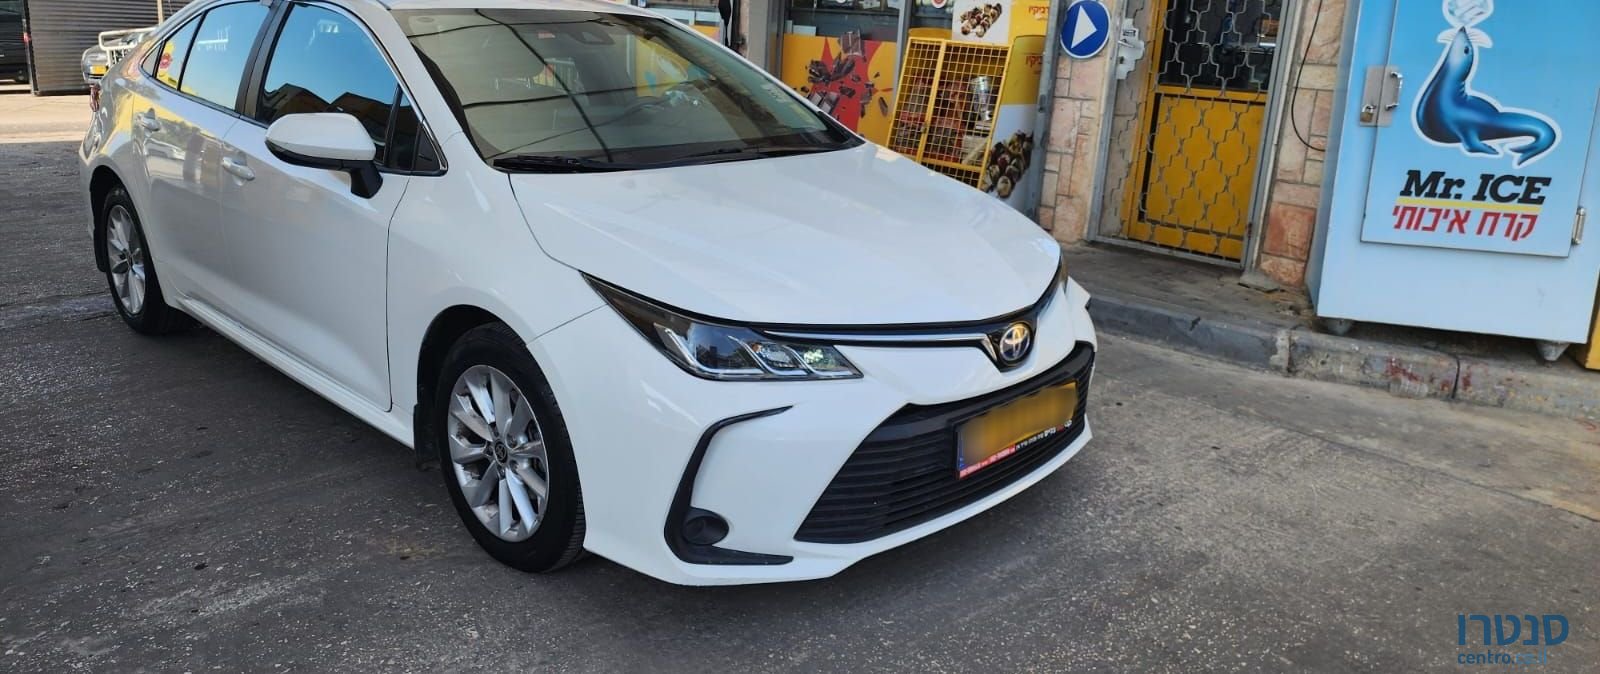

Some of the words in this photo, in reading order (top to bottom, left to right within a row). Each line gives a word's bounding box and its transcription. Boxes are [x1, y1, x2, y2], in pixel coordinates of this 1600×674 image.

[1400, 170, 1465, 200] Mr.
[1472, 174, 1552, 205] ICE
[1392, 205, 1471, 234] איכותי
[1476, 212, 1538, 241] קרח
